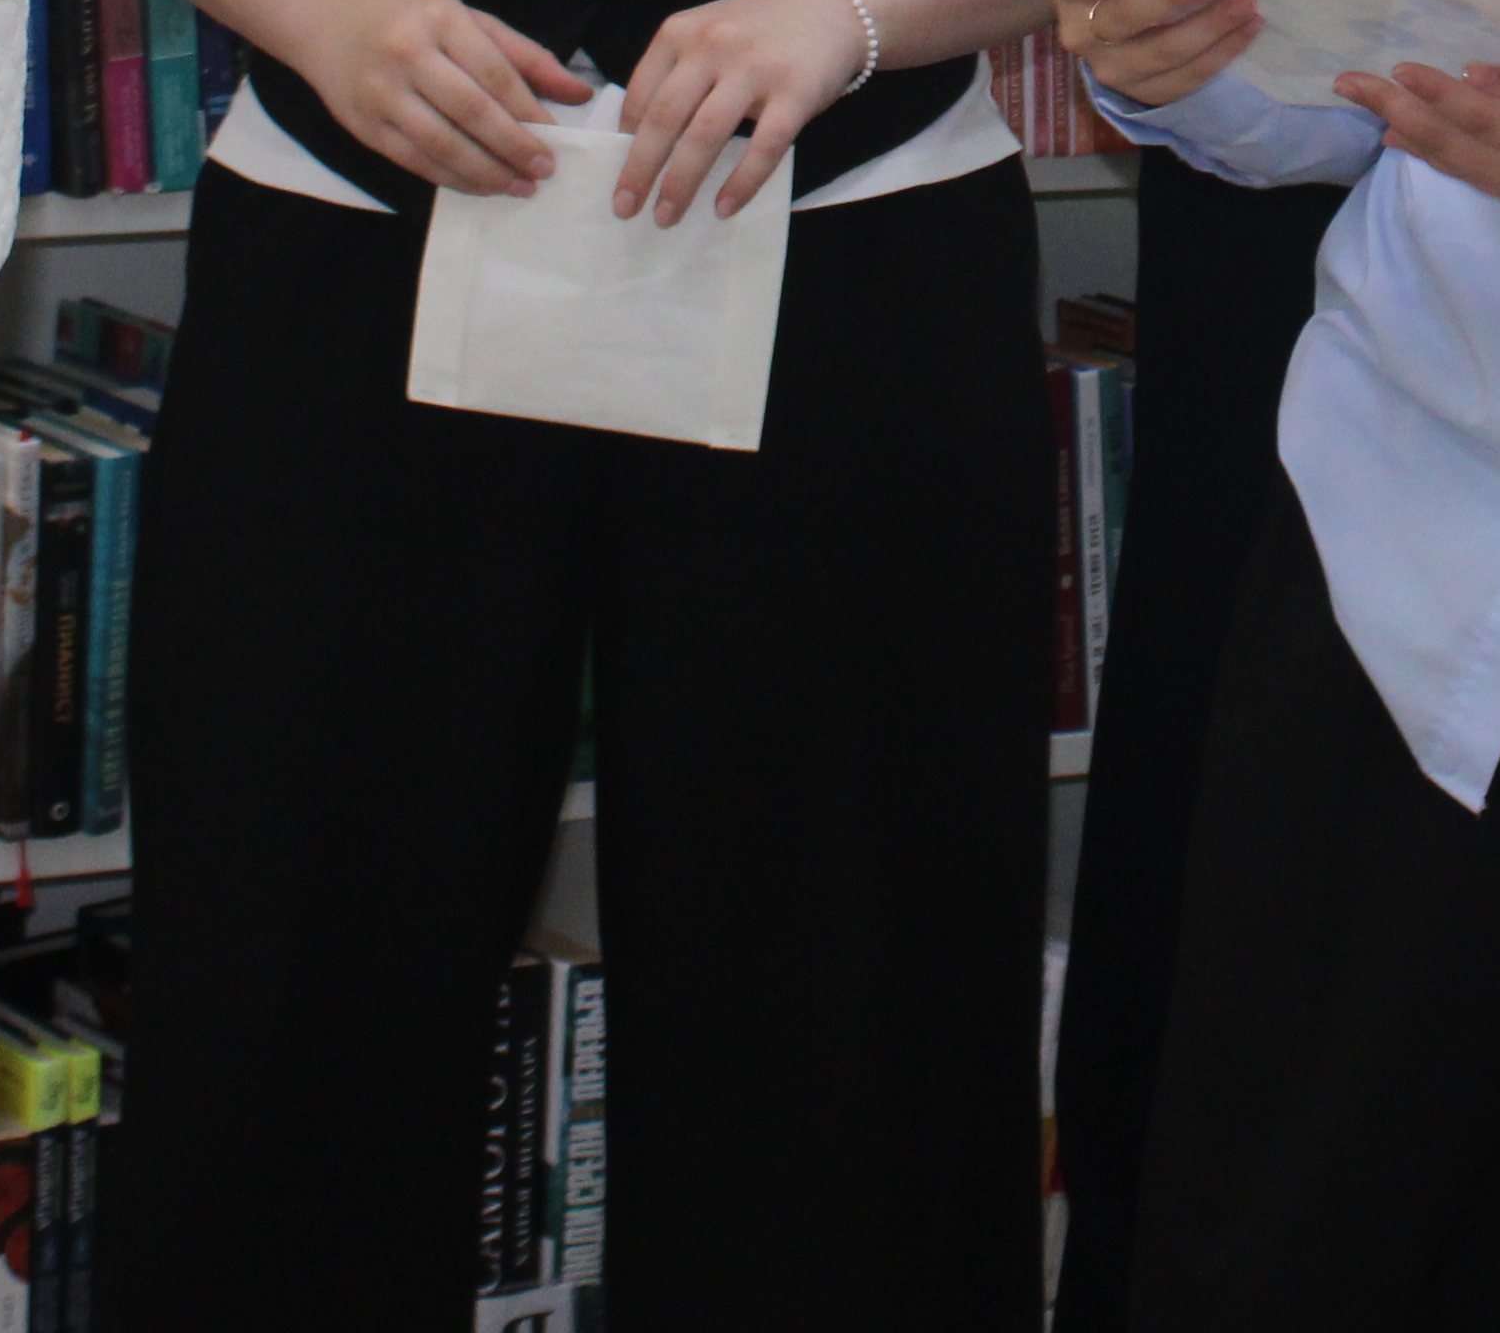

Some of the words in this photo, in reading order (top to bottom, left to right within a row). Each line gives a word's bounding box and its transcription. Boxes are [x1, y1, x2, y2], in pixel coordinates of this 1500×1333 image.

[53, 614, 77, 723] ПИАНИСТ
[516, 1035, 538, 1180] ЯНАГИХАРА
[565, 1120, 605, 1205] СРЕДИ
